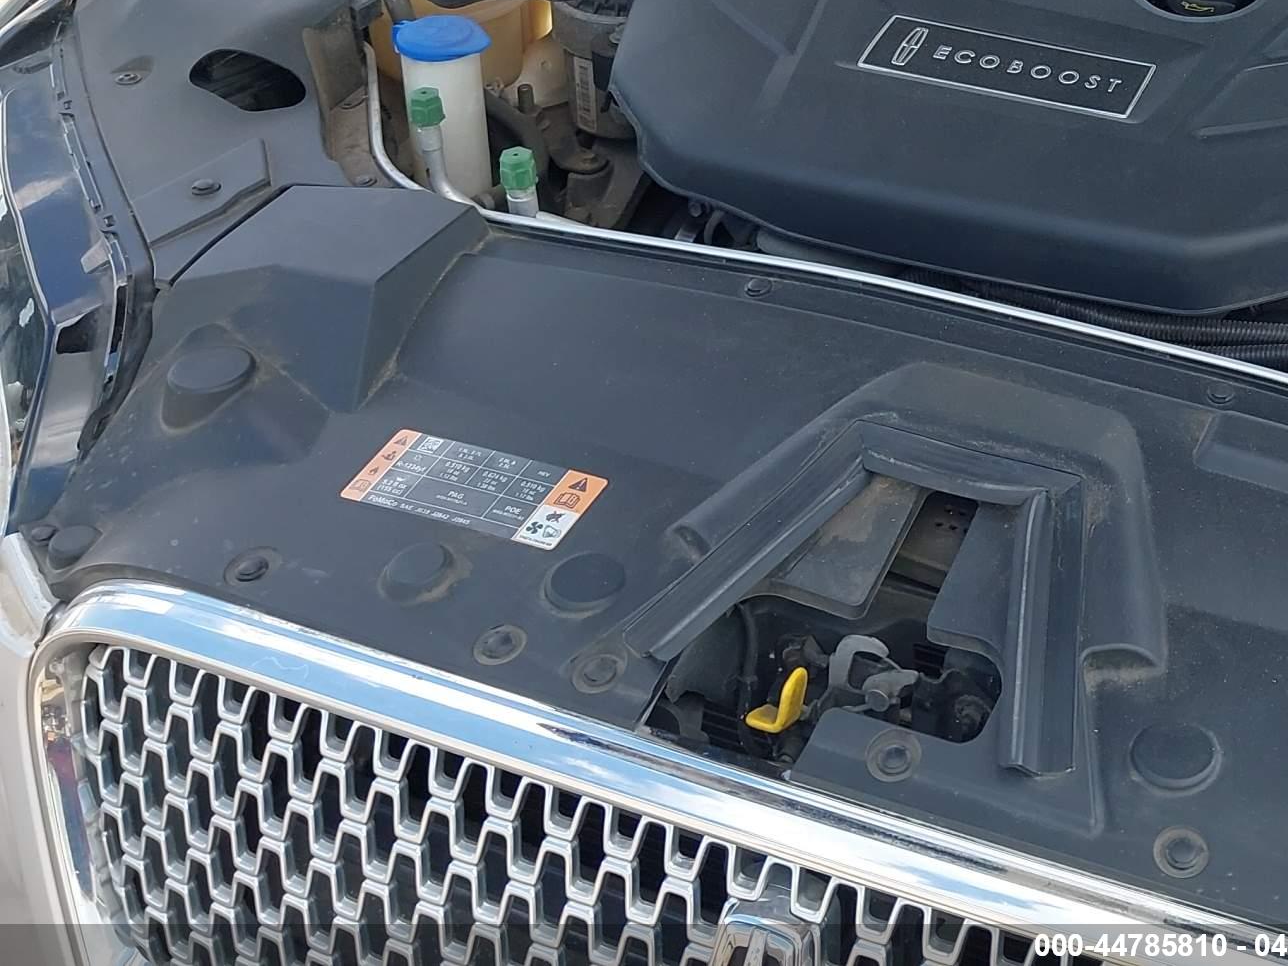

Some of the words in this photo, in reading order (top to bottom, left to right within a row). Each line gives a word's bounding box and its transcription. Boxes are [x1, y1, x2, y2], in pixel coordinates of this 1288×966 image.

[933, 45, 1122, 92] ECOBOOST
[394, 460, 428, 473] R-1234yf
[447, 490, 465, 500] PAG
[368, 495, 398, 507] FoMoCo
[399, 503, 414, 511] SAE
[504, 505, 522, 515] POE
